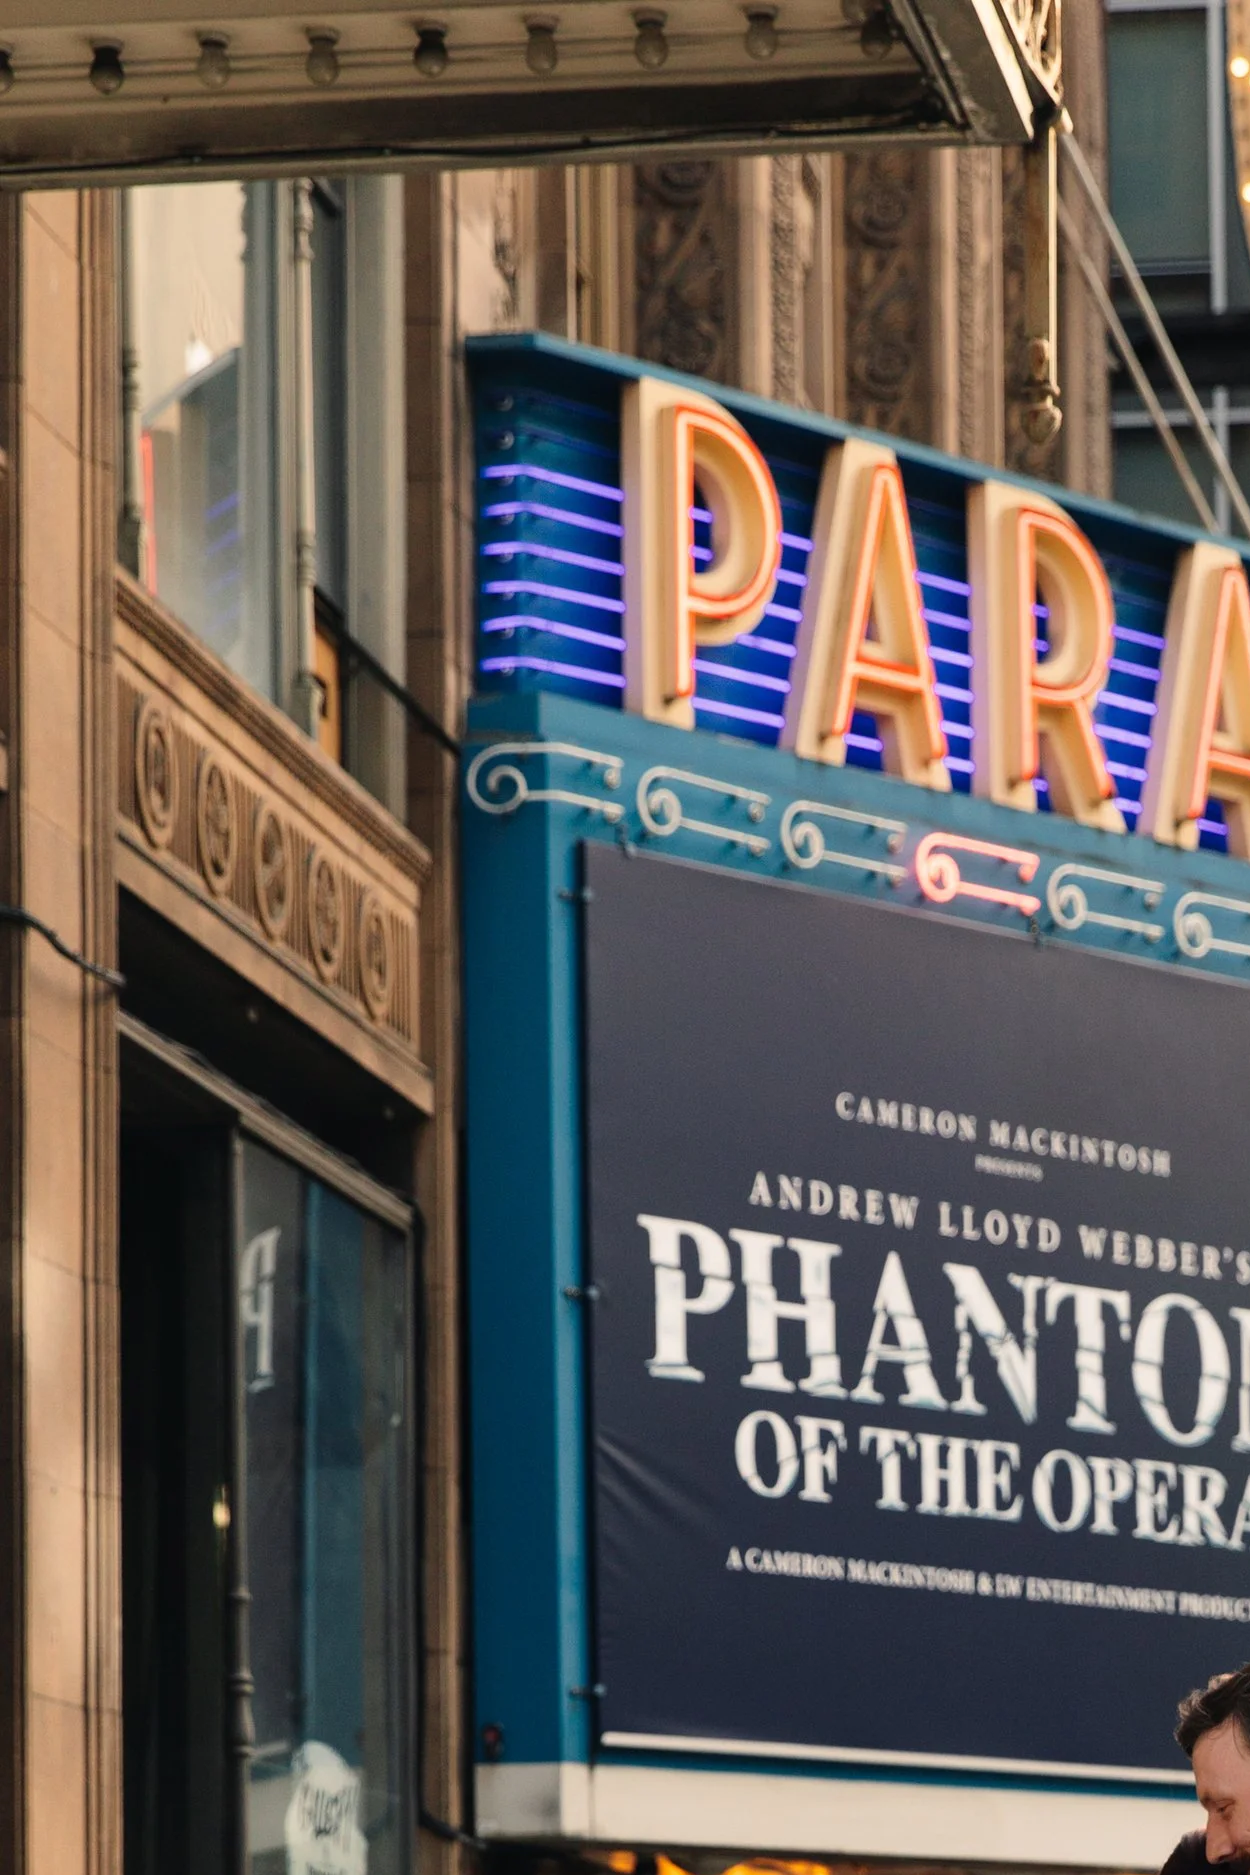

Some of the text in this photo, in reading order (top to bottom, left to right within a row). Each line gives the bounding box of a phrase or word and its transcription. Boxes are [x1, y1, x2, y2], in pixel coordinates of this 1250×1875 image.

[834, 1090, 1172, 1178] CAMERON MACKINTOSH
[748, 1170, 920, 1231] ANDREW
[937, 1201, 1062, 1254] LLOYD
[734, 1409, 848, 1504] OF
[858, 1426, 1025, 1524] THE
[726, 1545, 744, 1572] A
[744, 1546, 846, 1582] CAMERON
[846, 1557, 976, 1595] MACKINTOSH
[976, 1570, 995, 1597] &
[1026, 1575, 1177, 1616] ENTERTAINMENT
